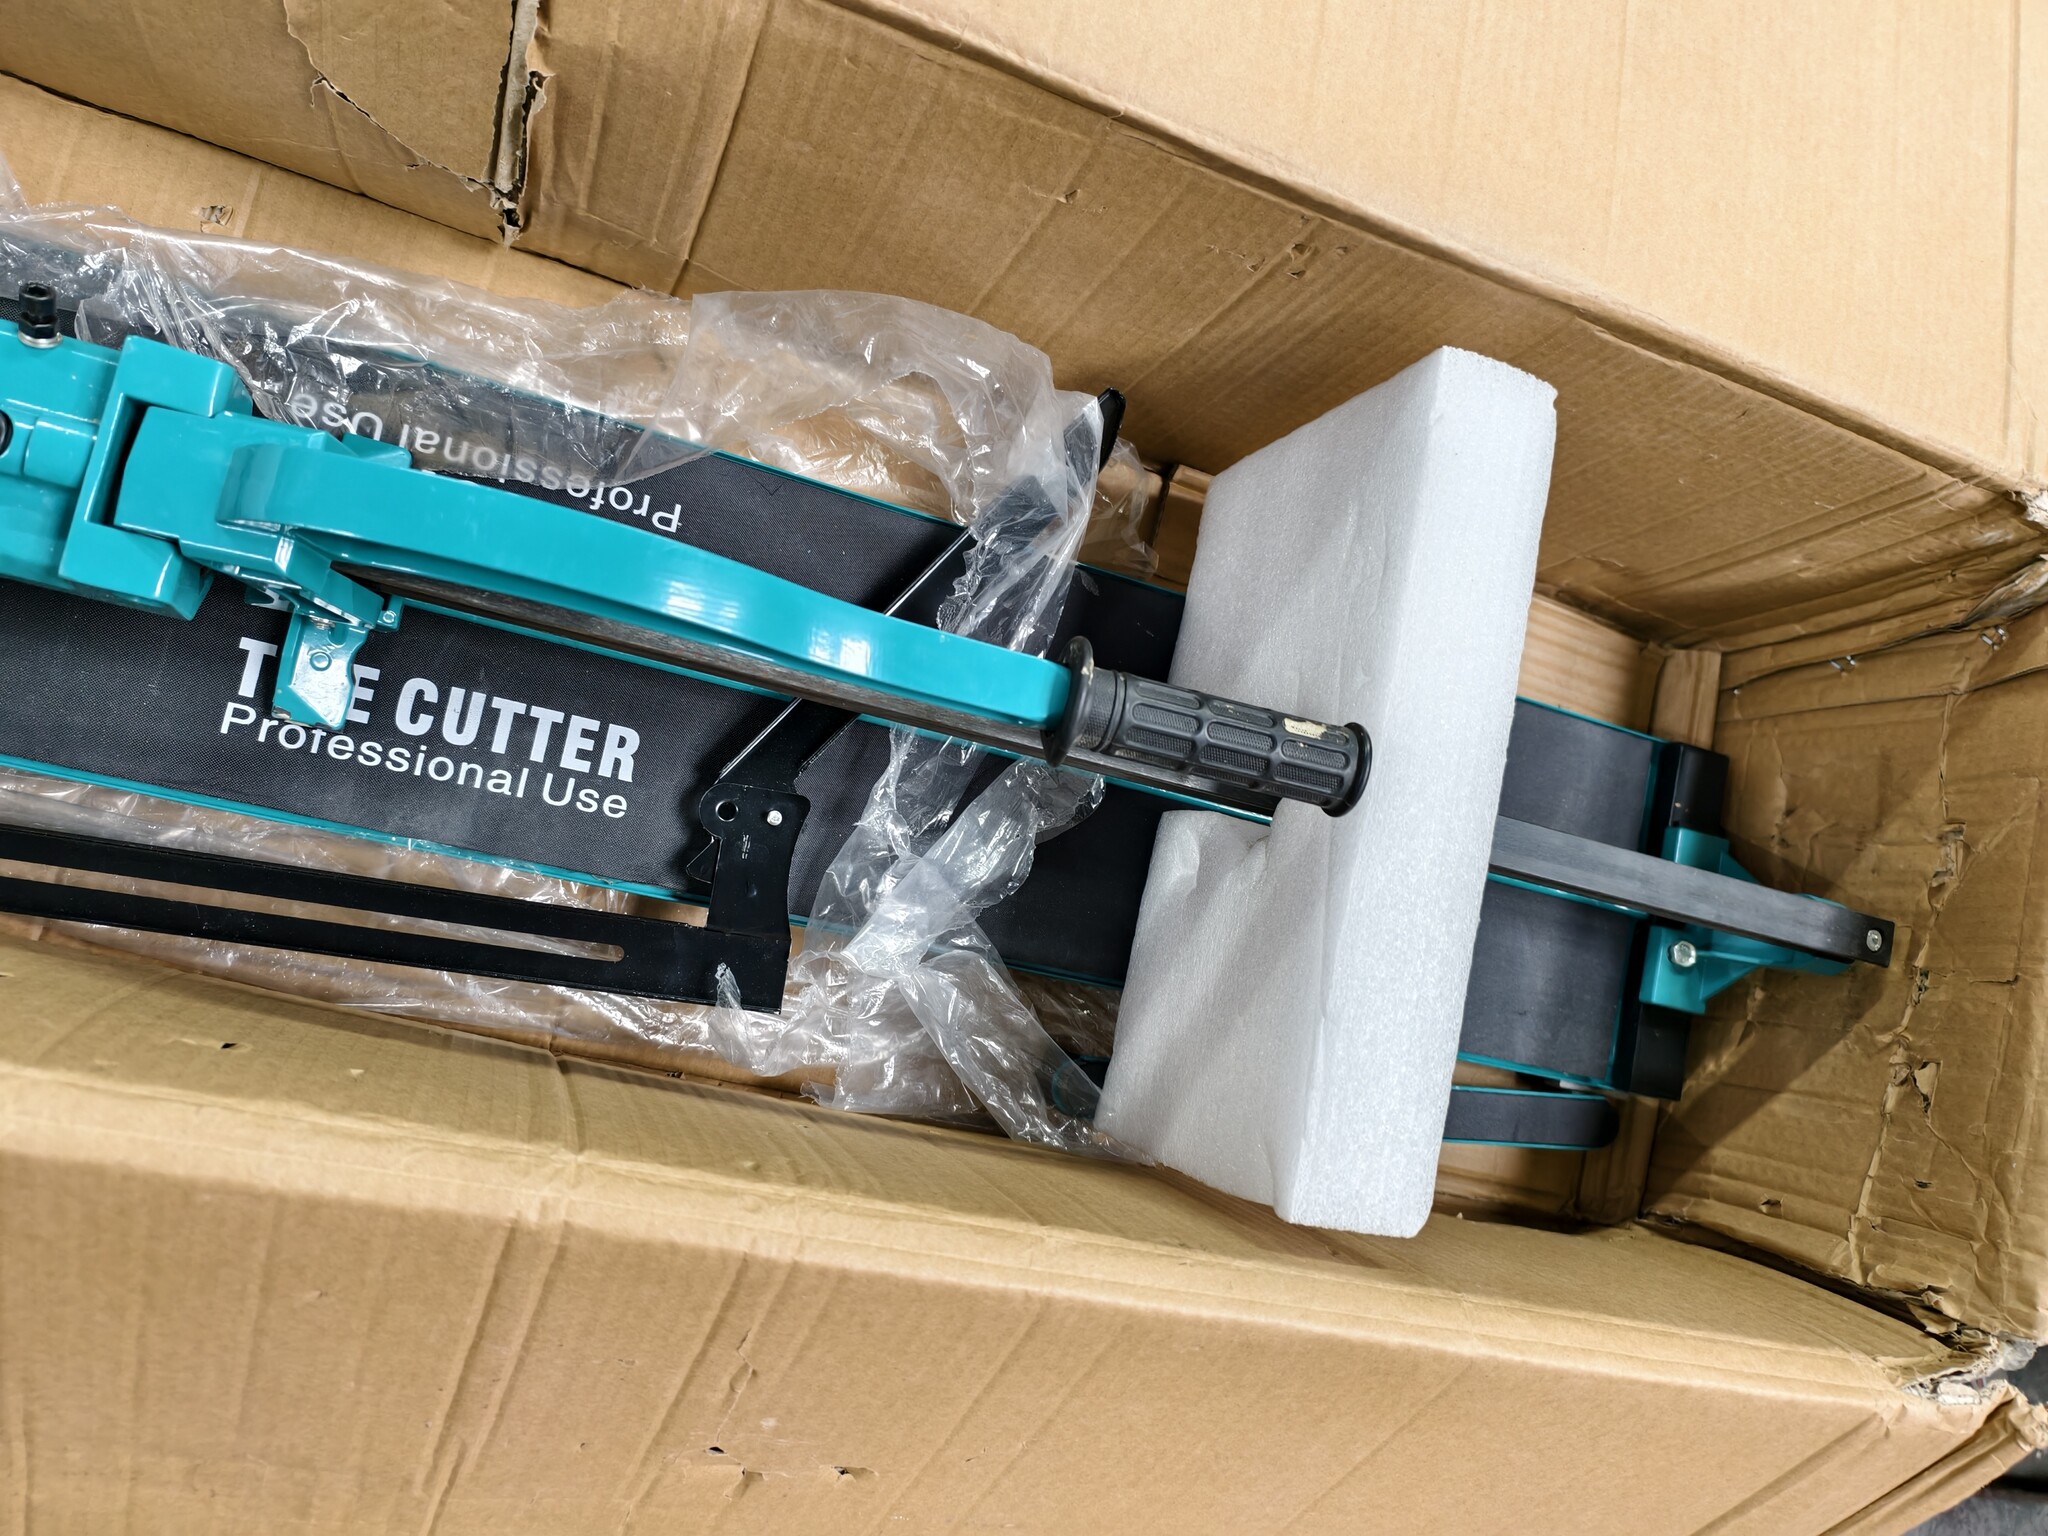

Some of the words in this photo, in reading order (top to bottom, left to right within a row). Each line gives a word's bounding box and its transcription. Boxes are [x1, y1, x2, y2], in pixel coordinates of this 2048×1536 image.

[289, 393, 384, 441] Use
[400, 423, 683, 533] Professional
[220, 702, 530, 798] Professional
[543, 776, 628, 819] Use
[239, 637, 381, 724] TE
[395, 677, 640, 782] CUTTER
